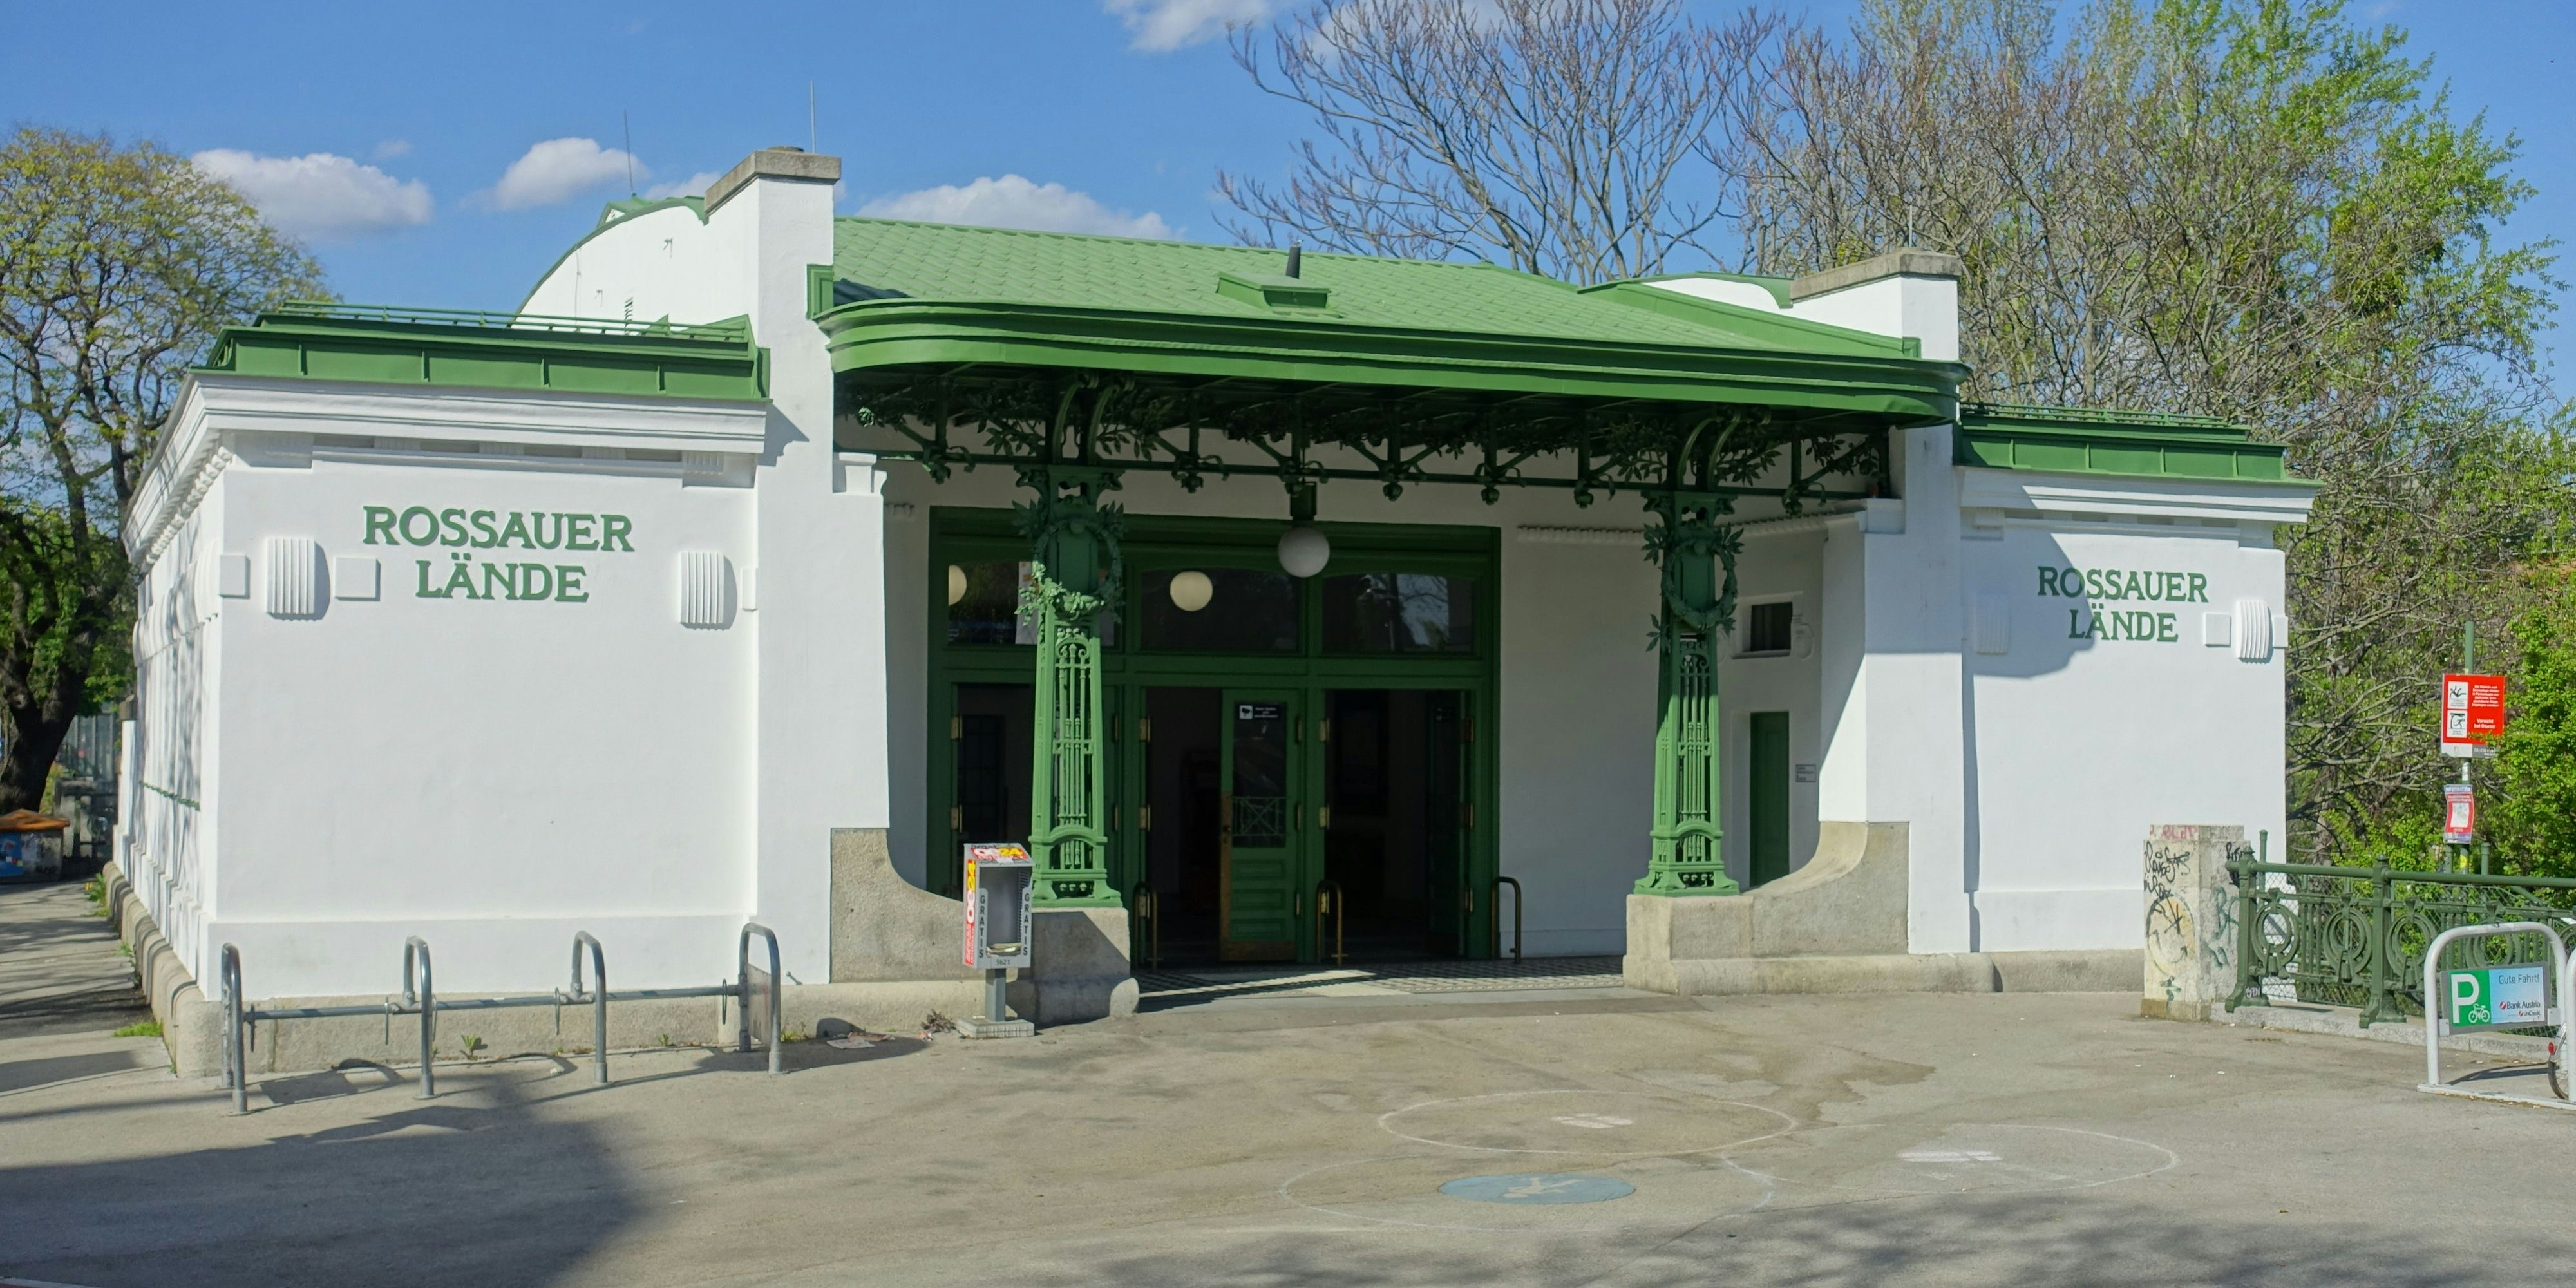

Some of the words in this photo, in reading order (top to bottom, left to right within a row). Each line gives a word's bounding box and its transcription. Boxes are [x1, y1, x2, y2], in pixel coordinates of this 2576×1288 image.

[363, 506, 635, 552] ROSSAUER
[415, 552, 589, 603] LÄNDE
[2038, 566, 2209, 603] ROSSAUER
[2069, 603, 2179, 642] LÄNDE
[2450, 974, 2479, 1023] P
[2499, 974, 2516, 984] Gute
[2518, 974, 2539, 983] Fahrt!
[2522, 1000, 2541, 1009] Austria
